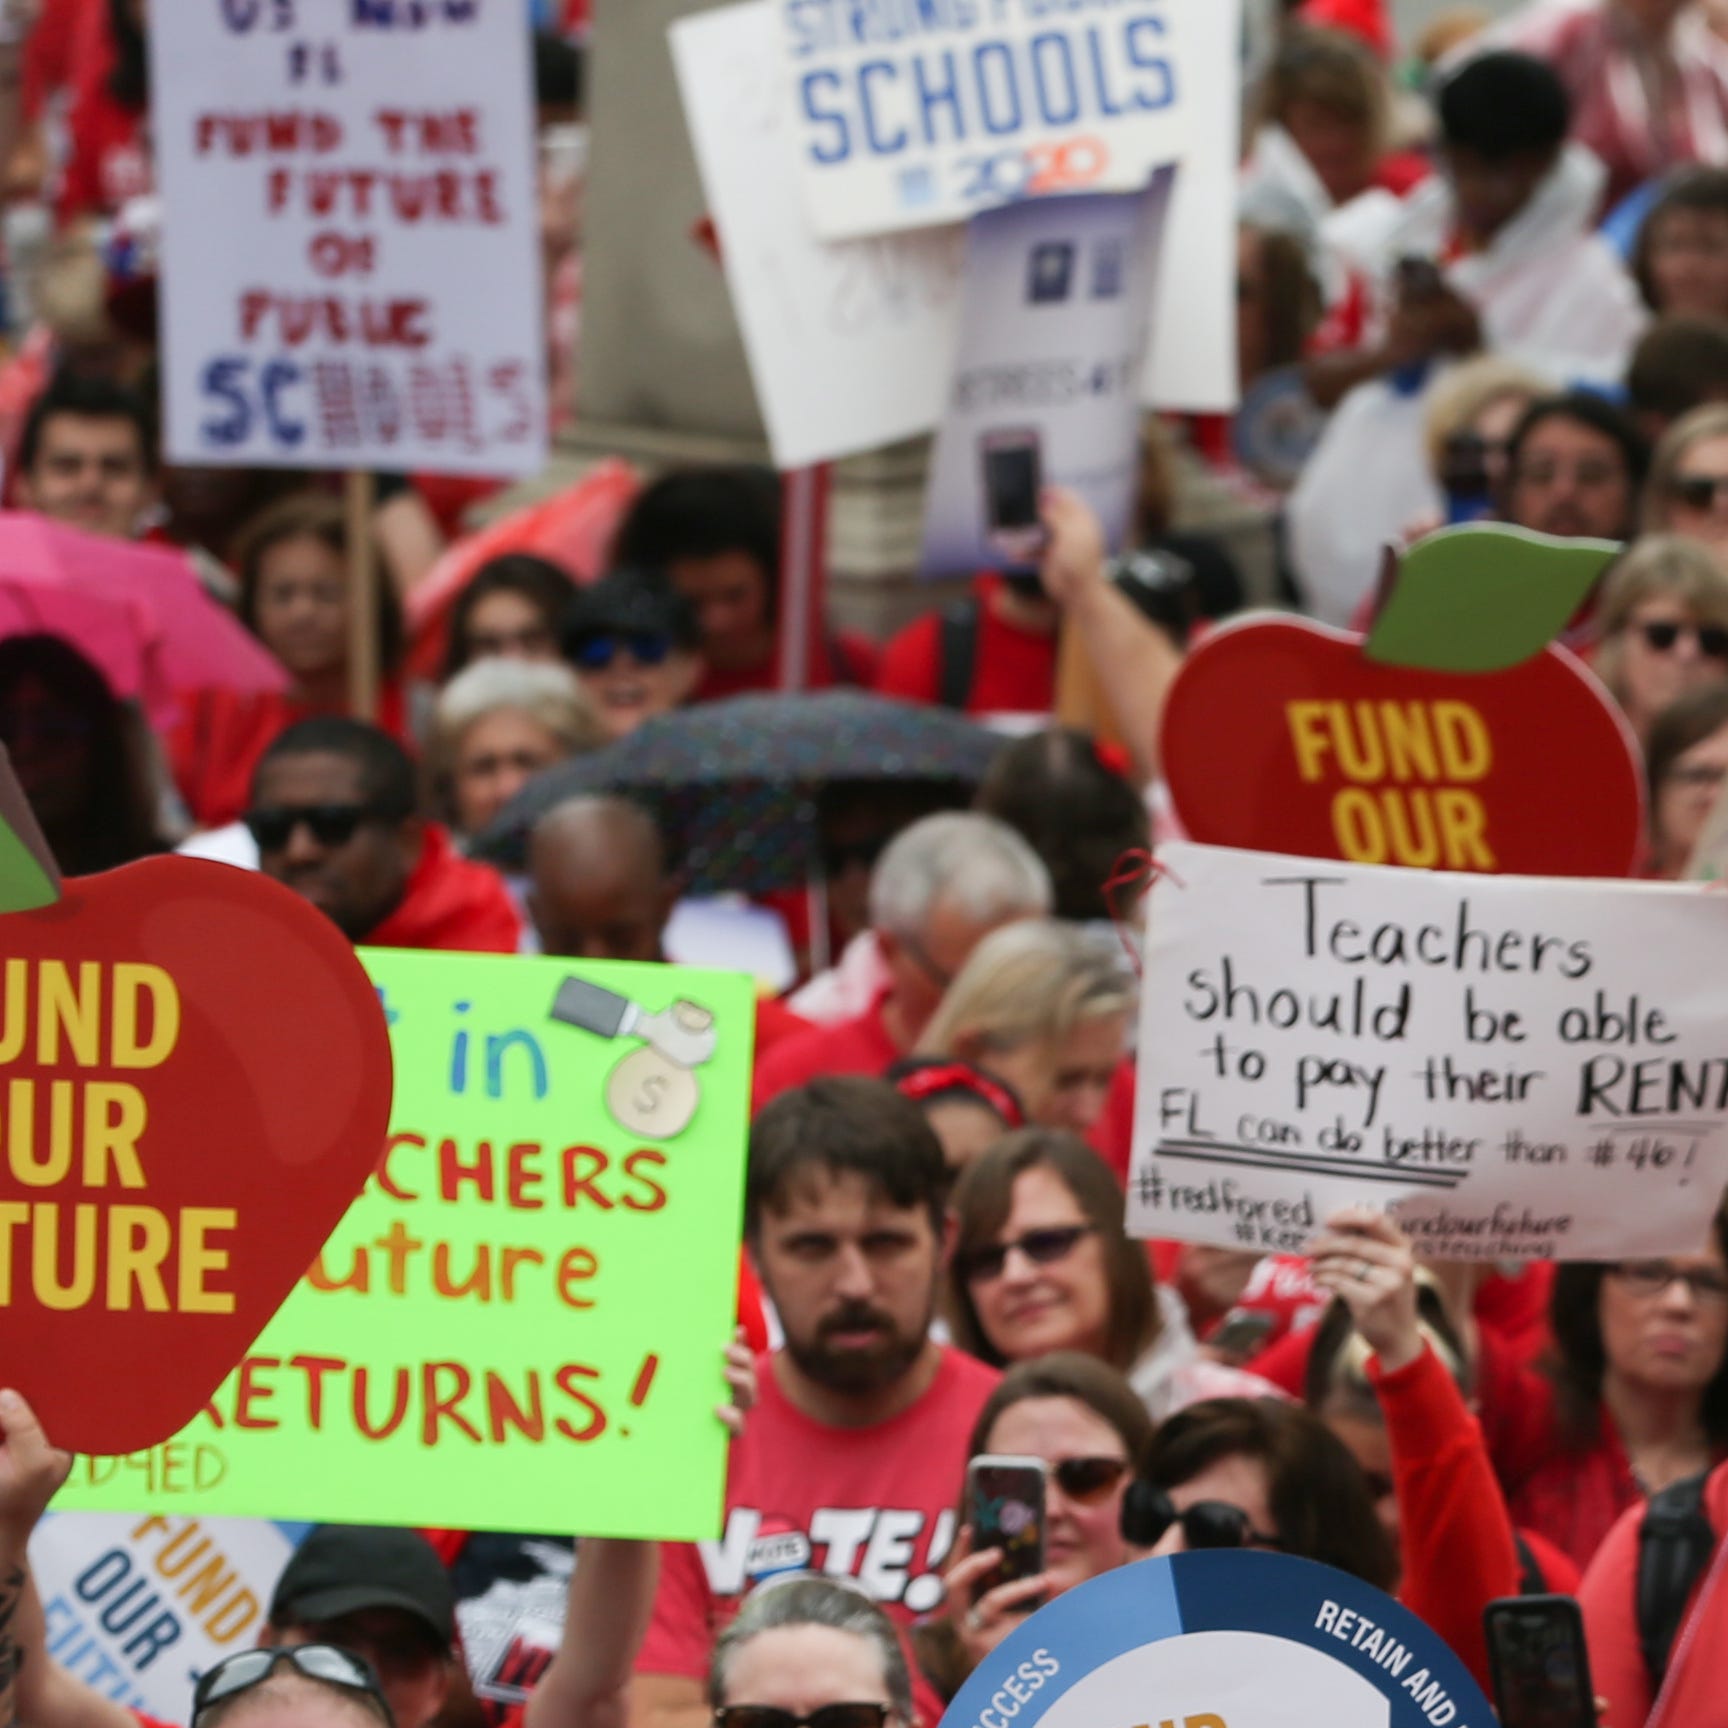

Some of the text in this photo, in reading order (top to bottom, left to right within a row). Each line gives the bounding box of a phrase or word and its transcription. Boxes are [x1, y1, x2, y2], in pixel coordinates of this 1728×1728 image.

[197, 104, 484, 156] FUND THE
[800, 14, 1180, 168] SCHOOLS
[267, 171, 508, 226] FUTURE
[238, 290, 433, 350] PUBLIC
[1286, 700, 1491, 782] FUND
[1333, 788, 1498, 869] OUR
[1261, 874, 1594, 979] Teachers
[1185, 956, 1679, 1046] should be able
[450, 1001, 549, 1100] in
[1203, 1035, 1268, 1085] to
[1293, 1055, 1386, 1128] pay
[1413, 1050, 1546, 1105] their
[1160, 1088, 1216, 1138] FL
[1236, 1111, 1302, 1147] can
[1317, 1113, 1363, 1154] do
[1382, 1125, 1484, 1166] better
[1500, 1128, 1569, 1164] than
[74, 1547, 183, 1672] OUR
[1313, 1599, 1414, 1680] RETAIN
